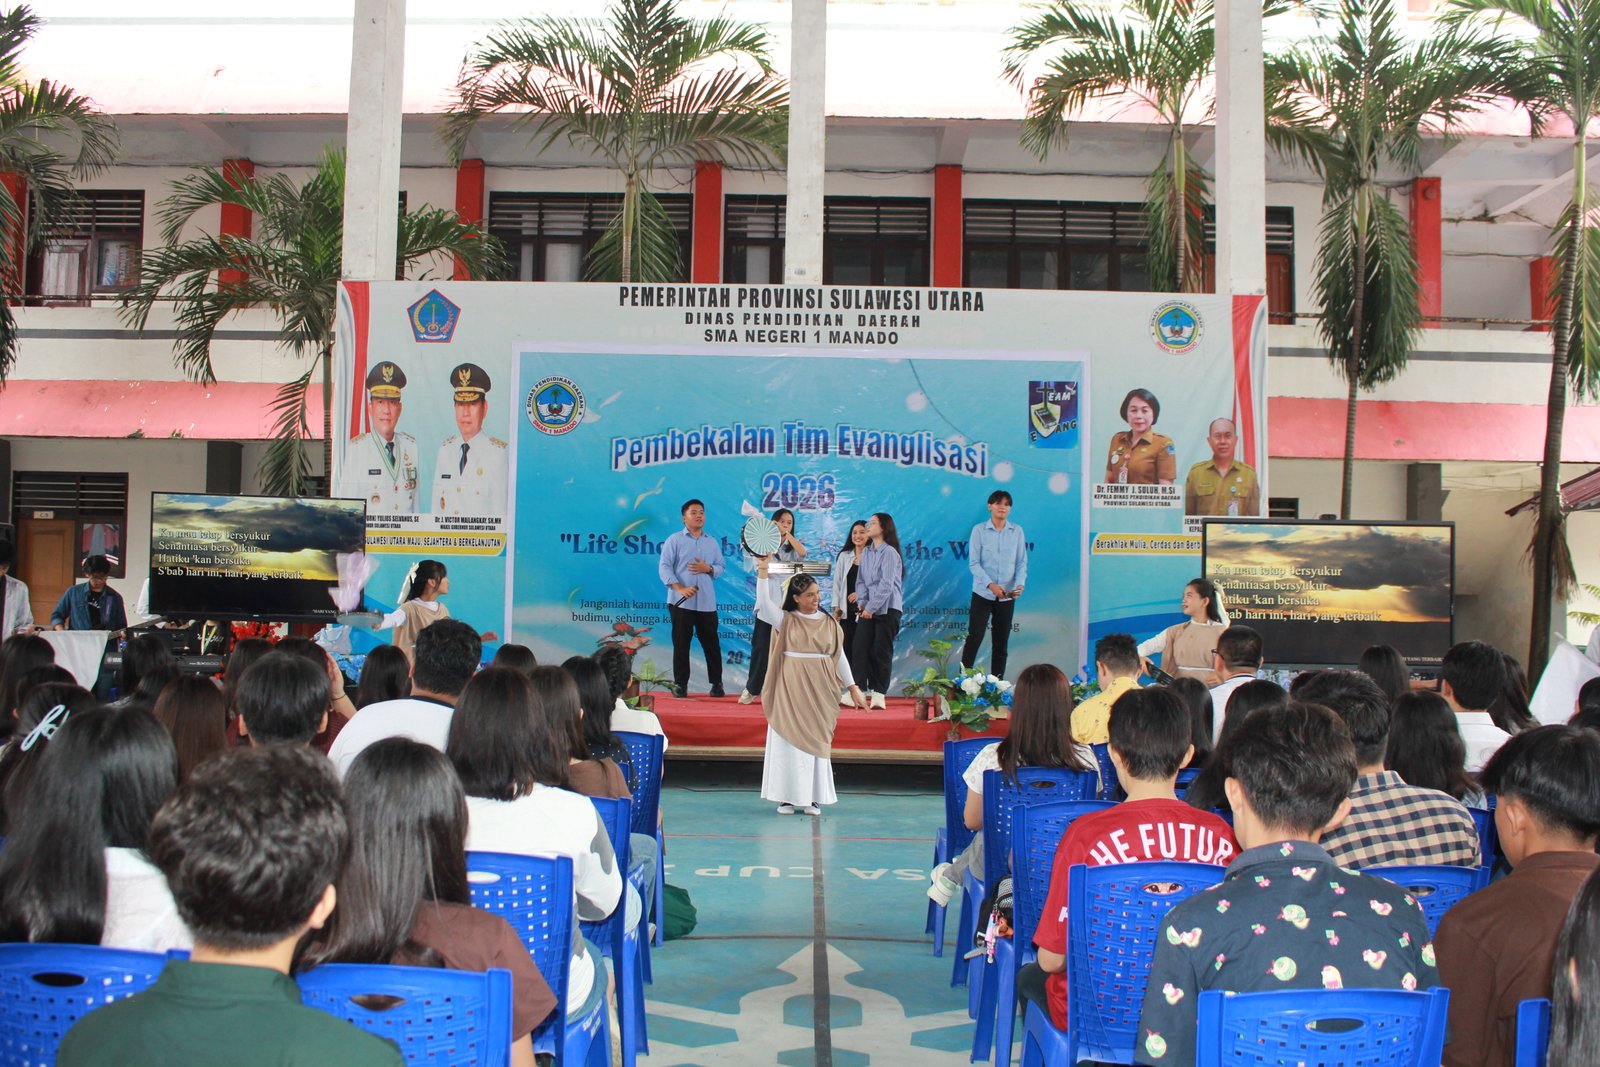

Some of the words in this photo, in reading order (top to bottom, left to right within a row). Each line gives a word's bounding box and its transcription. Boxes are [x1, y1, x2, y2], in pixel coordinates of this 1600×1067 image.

[619, 286, 730, 308] PEMERINTAH
[738, 288, 822, 309] PROVINSI
[830, 289, 920, 310] SULAWESI
[928, 291, 984, 311] UTARA
[685, 312, 734, 325] DINAS
[743, 313, 843, 326] PENDIDIKAN
[858, 314, 920, 328] DAERAH
[704, 329, 738, 343] SMA
[746, 330, 805, 343] NEGERI
[814, 331, 820, 344] 1
[829, 331, 898, 344] MANADO
[527, 389, 536, 408] DINAS
[535, 377, 572, 389] PENDIDIKAN
[572, 384, 584, 409] DAERAH
[533, 420, 548, 433] SMAN
[554, 420, 577, 434] MANADO
[613, 422, 775, 470] Pembekalan
[783, 422, 829, 455] Tim
[838, 426, 986, 476] Evanglisasi
[762, 474, 836, 510] 2026
[1107, 486, 1129, 494] FEMMY
[225, 530, 271, 543] bersyukur
[390, 537, 406, 545] UTARA
[407, 537, 423, 546] MAJU,
[424, 537, 452, 546] SEJAHTERA
[459, 538, 501, 547] BERKELANJUTAN
[158, 541, 208, 551] Senantiasa
[211, 543, 258, 555] bersyukur
[560, 534, 618, 554] "Life
[905, 540, 944, 561] the
[1096, 540, 1127, 549] Berakhlak
[1130, 540, 1149, 549] Mulia,
[1150, 540, 1171, 549] Cerdas
[1173, 540, 1184, 549] dan
[158, 554, 190, 564] Hatiku
[214, 556, 251, 565] bersuka
[158, 567, 184, 577] S'bab
[186, 568, 204, 577] hari
[208, 568, 223, 578] ini,
[225, 568, 243, 578] hari
[246, 571, 269, 581] yang
[271, 571, 303, 580] terbaik
[1290, 565, 1342, 578] bersyukur
[1214, 579, 1270, 590] Senantiasa
[1274, 580, 1327, 593] bersyukur
[580, 599, 631, 612] Janganlah
[632, 600, 660, 610] kamu
[920, 605, 940, 615] oleh
[1278, 595, 1320, 606] bersuka
[572, 612, 613, 624] budimu,
[615, 614, 656, 625] sehingga
[922, 622, 940, 631] apa
[943, 622, 967, 632] yang
[1246, 610, 1266, 620] hari
[1270, 610, 1287, 622] ini,
[1290, 610, 1311, 620] hari
[1314, 613, 1341, 624] yang
[1344, 612, 1381, 622] terbaik
[1138, 822, 1234, 866] FUTUR
